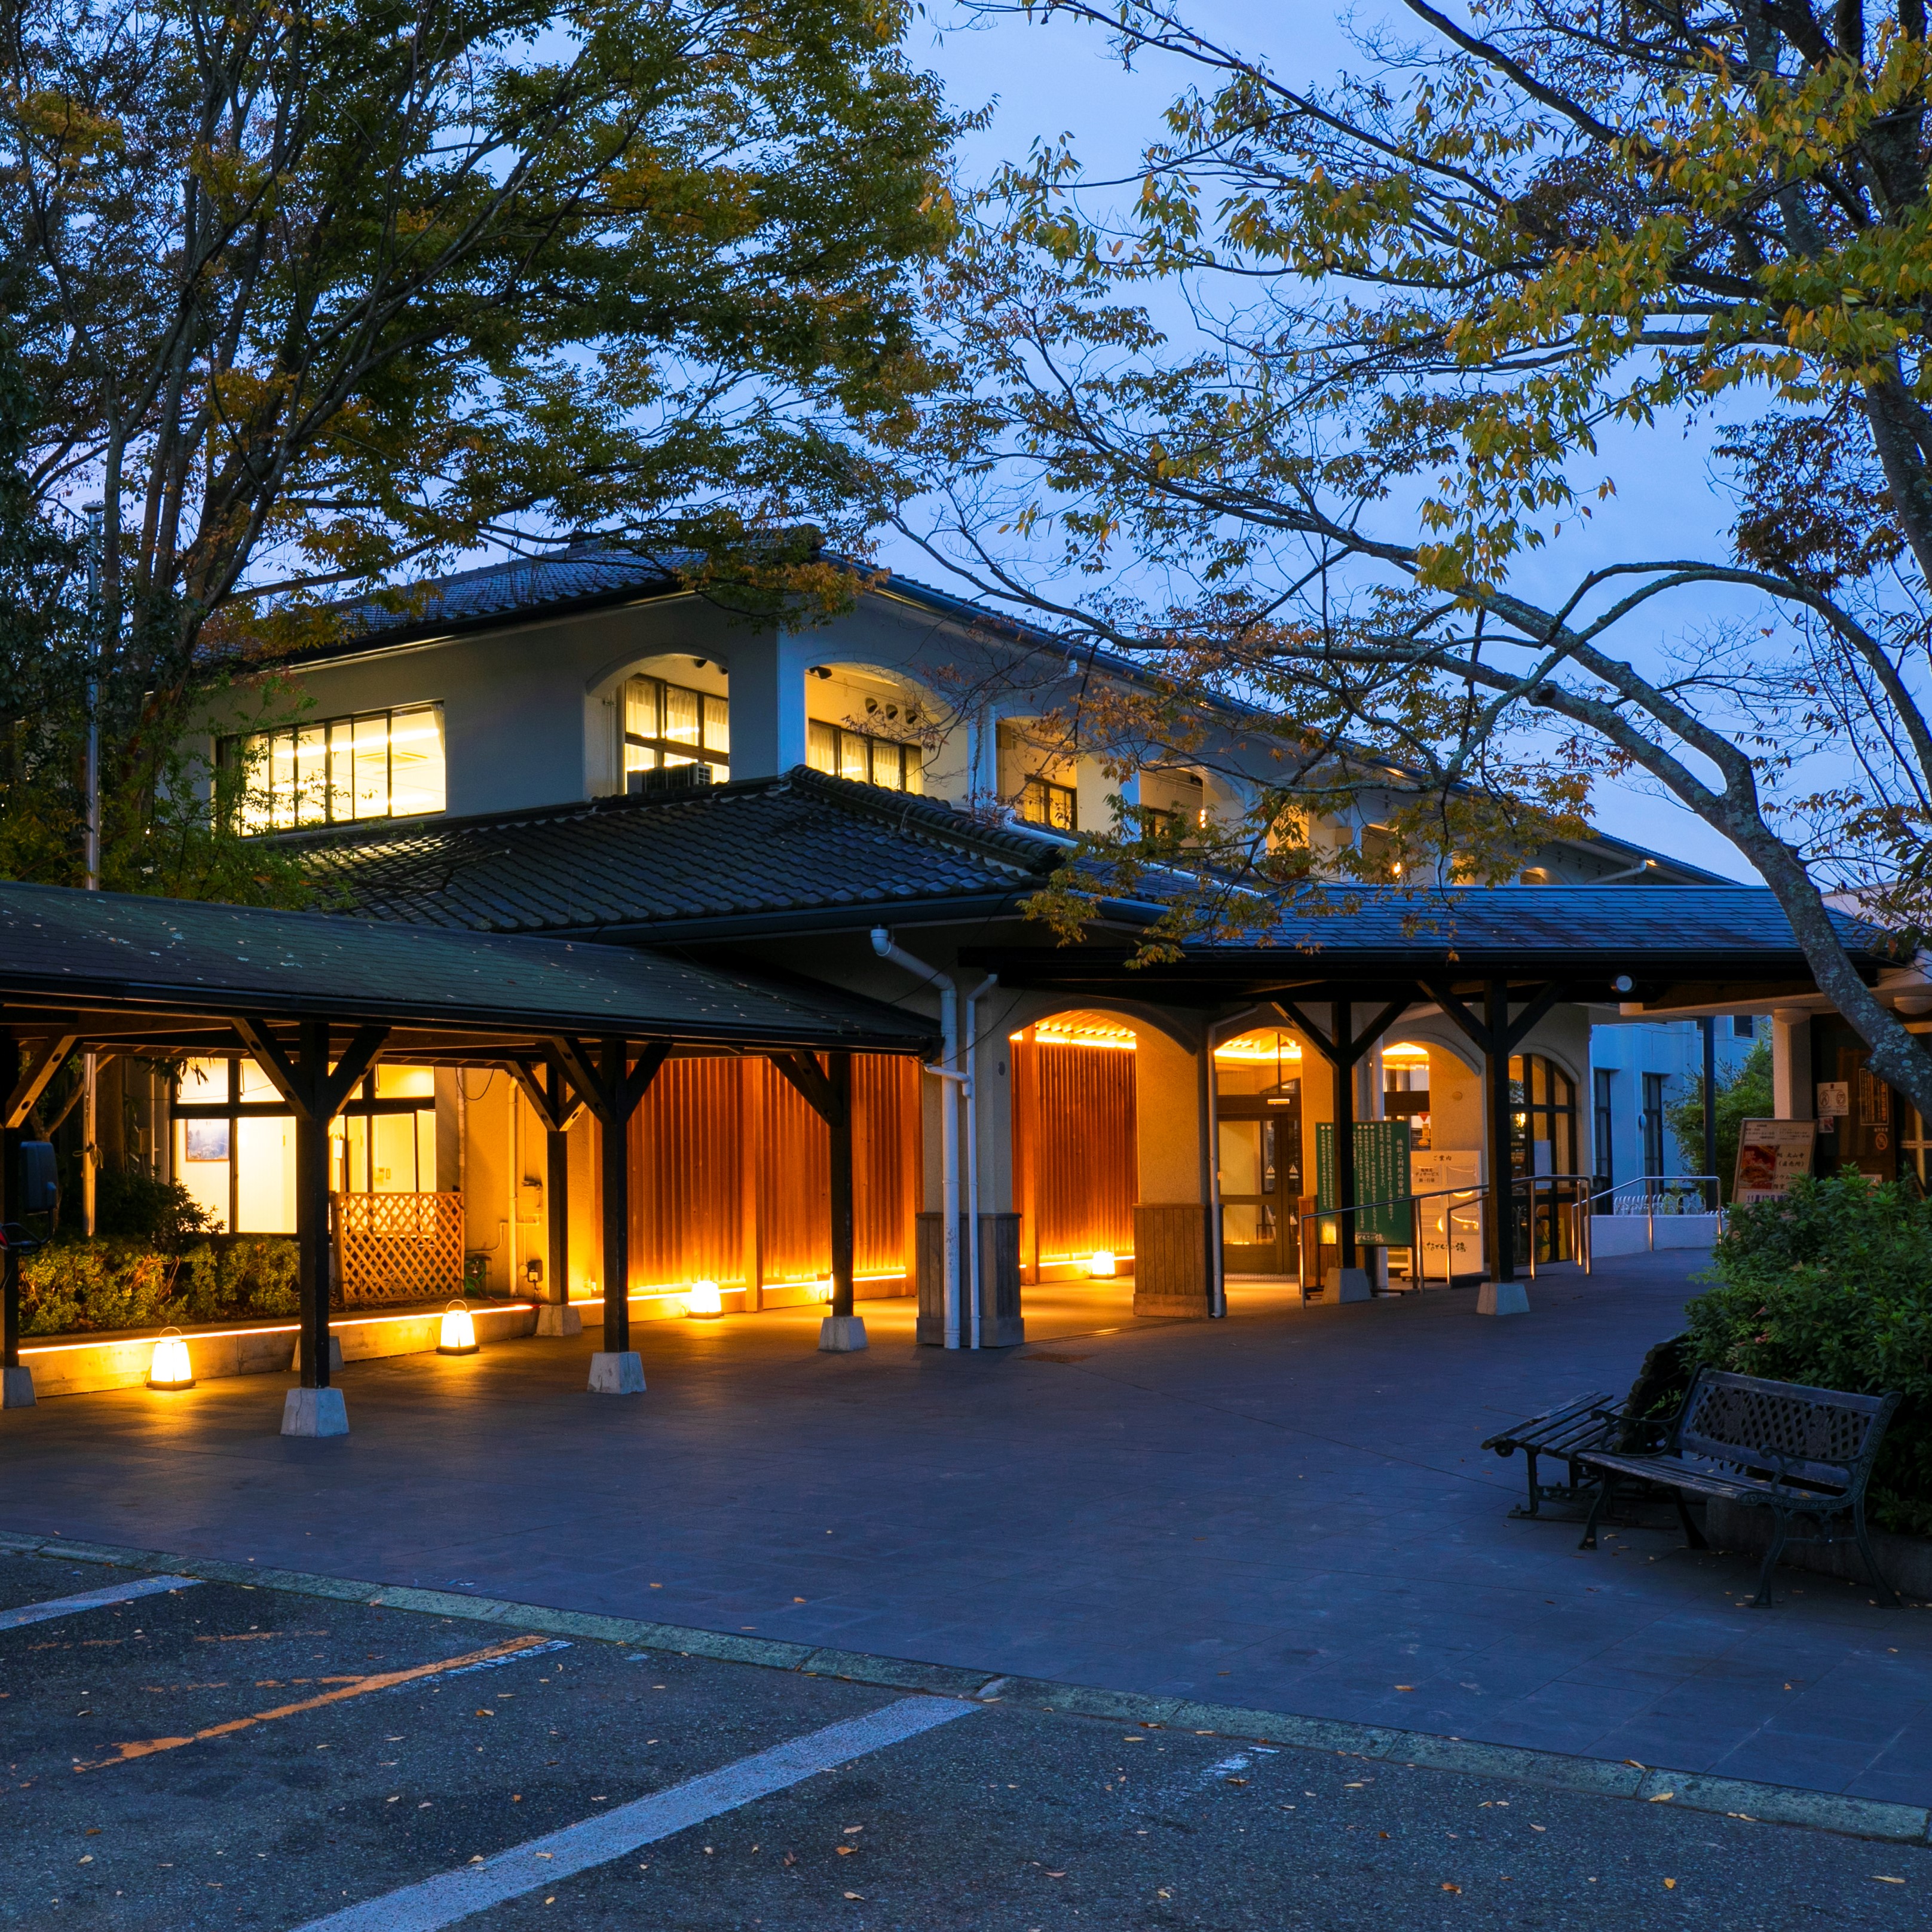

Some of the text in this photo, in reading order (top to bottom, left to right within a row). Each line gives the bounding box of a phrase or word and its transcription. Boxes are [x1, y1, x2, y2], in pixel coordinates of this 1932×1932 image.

[1355, 1233, 1385, 1242] でしこの湯
